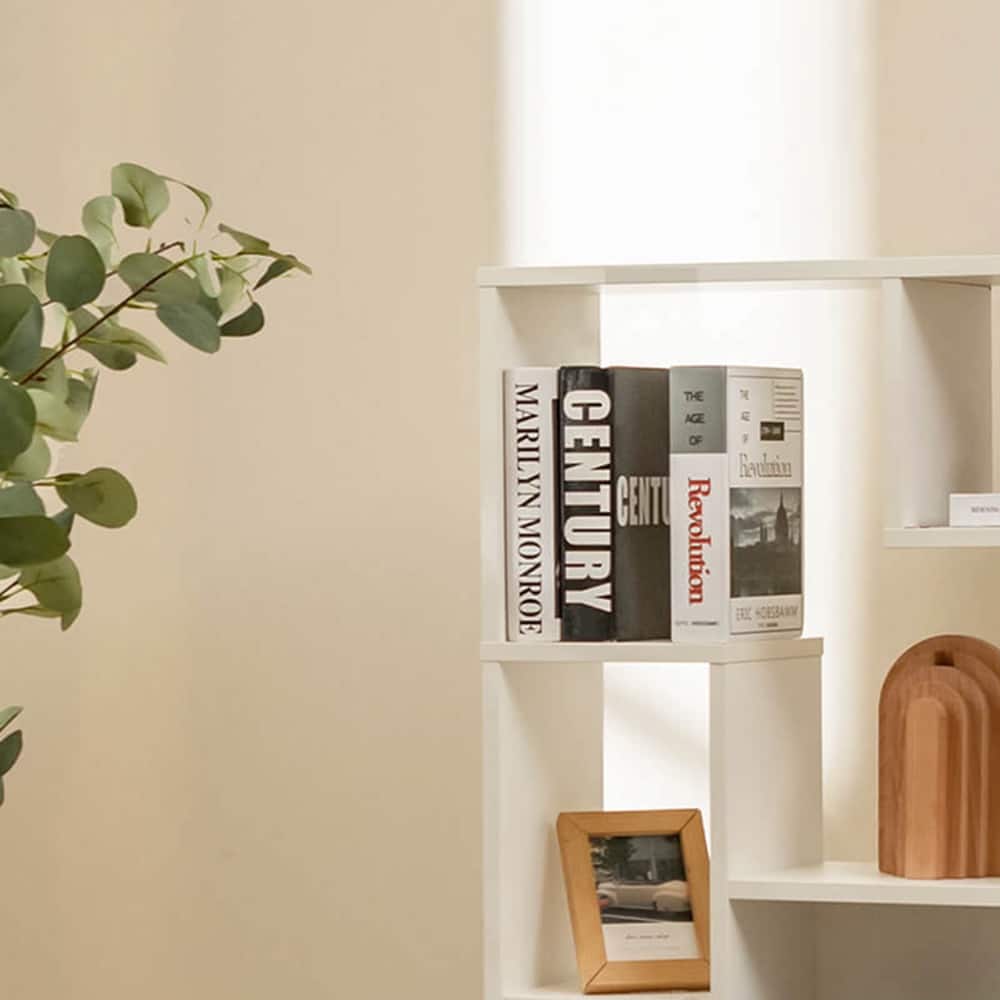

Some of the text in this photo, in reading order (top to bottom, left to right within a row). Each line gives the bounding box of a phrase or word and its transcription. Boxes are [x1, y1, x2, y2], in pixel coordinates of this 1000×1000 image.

[683, 390, 705, 402] THE
[684, 412, 705, 425] AGE
[688, 434, 704, 447] OF
[514, 383, 543, 635] MARILYN MONROE
[562, 389, 612, 613] CENTURY
[688, 477, 712, 605] Revolution
